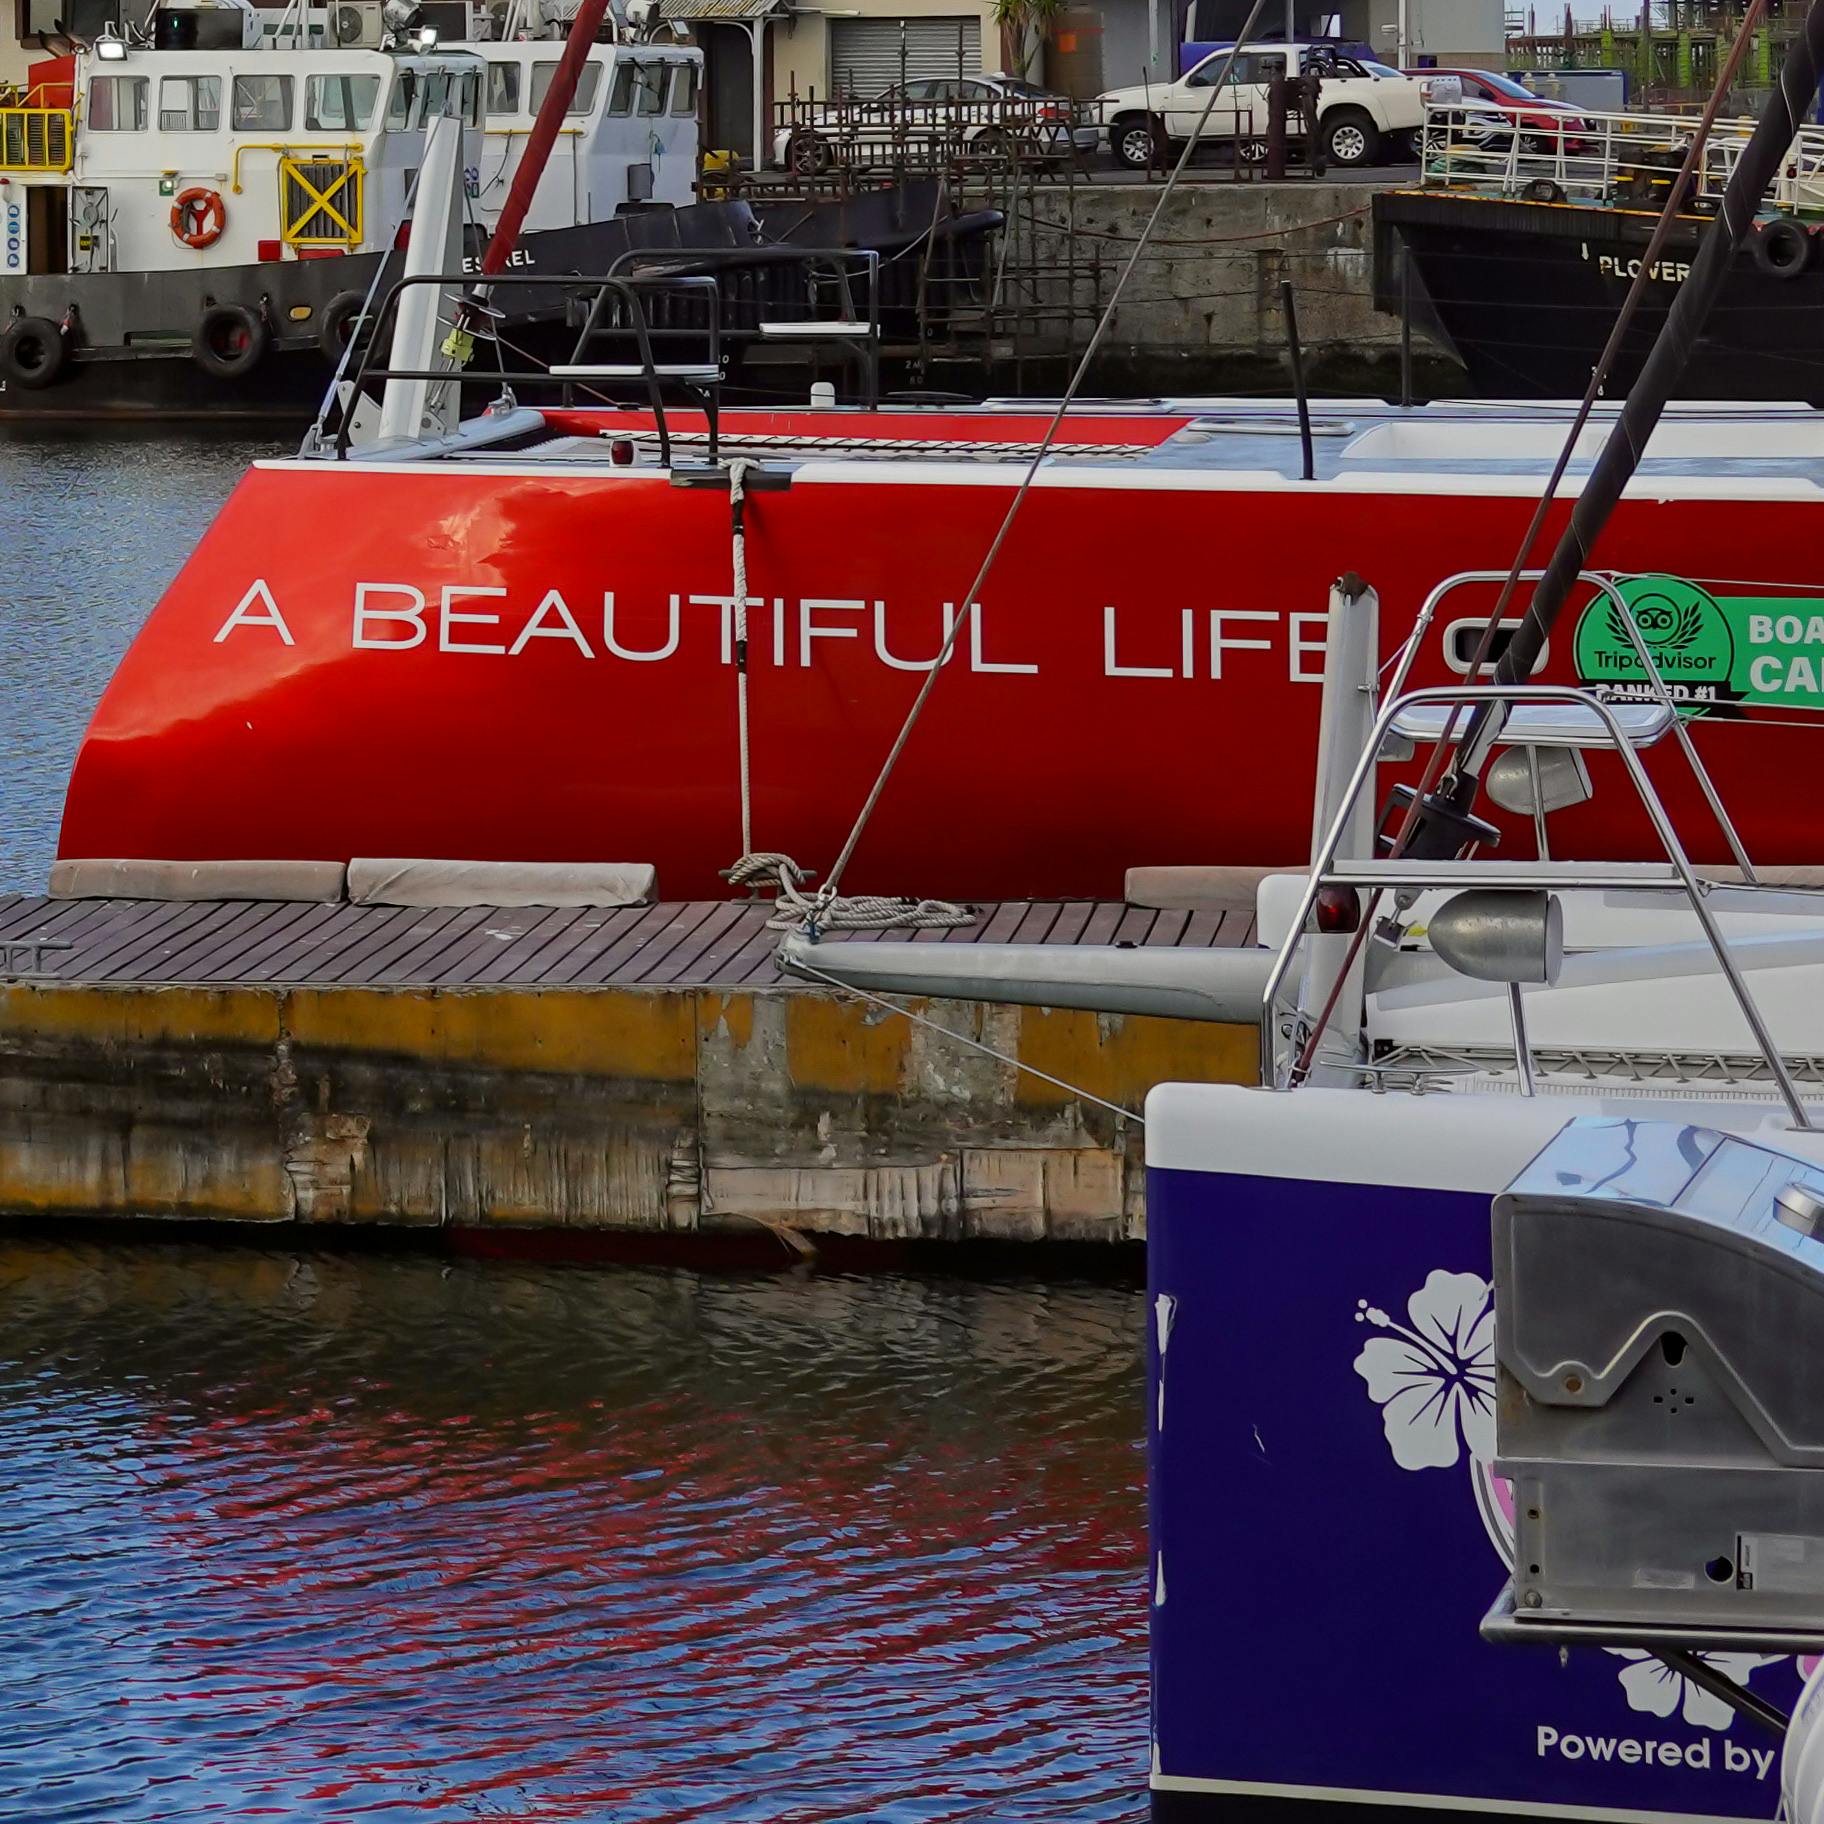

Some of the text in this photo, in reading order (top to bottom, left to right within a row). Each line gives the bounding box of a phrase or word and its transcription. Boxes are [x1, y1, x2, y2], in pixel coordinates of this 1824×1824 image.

[462, 249, 536, 274] ESEL
[214, 579, 1329, 683] A BEAUTIFUL LIFE
[1749, 614, 1824, 644] BOA
[1750, 655, 1824, 693] CA
[1694, 685, 1716, 702] #1
[1535, 1725, 1776, 1781] Powered by
